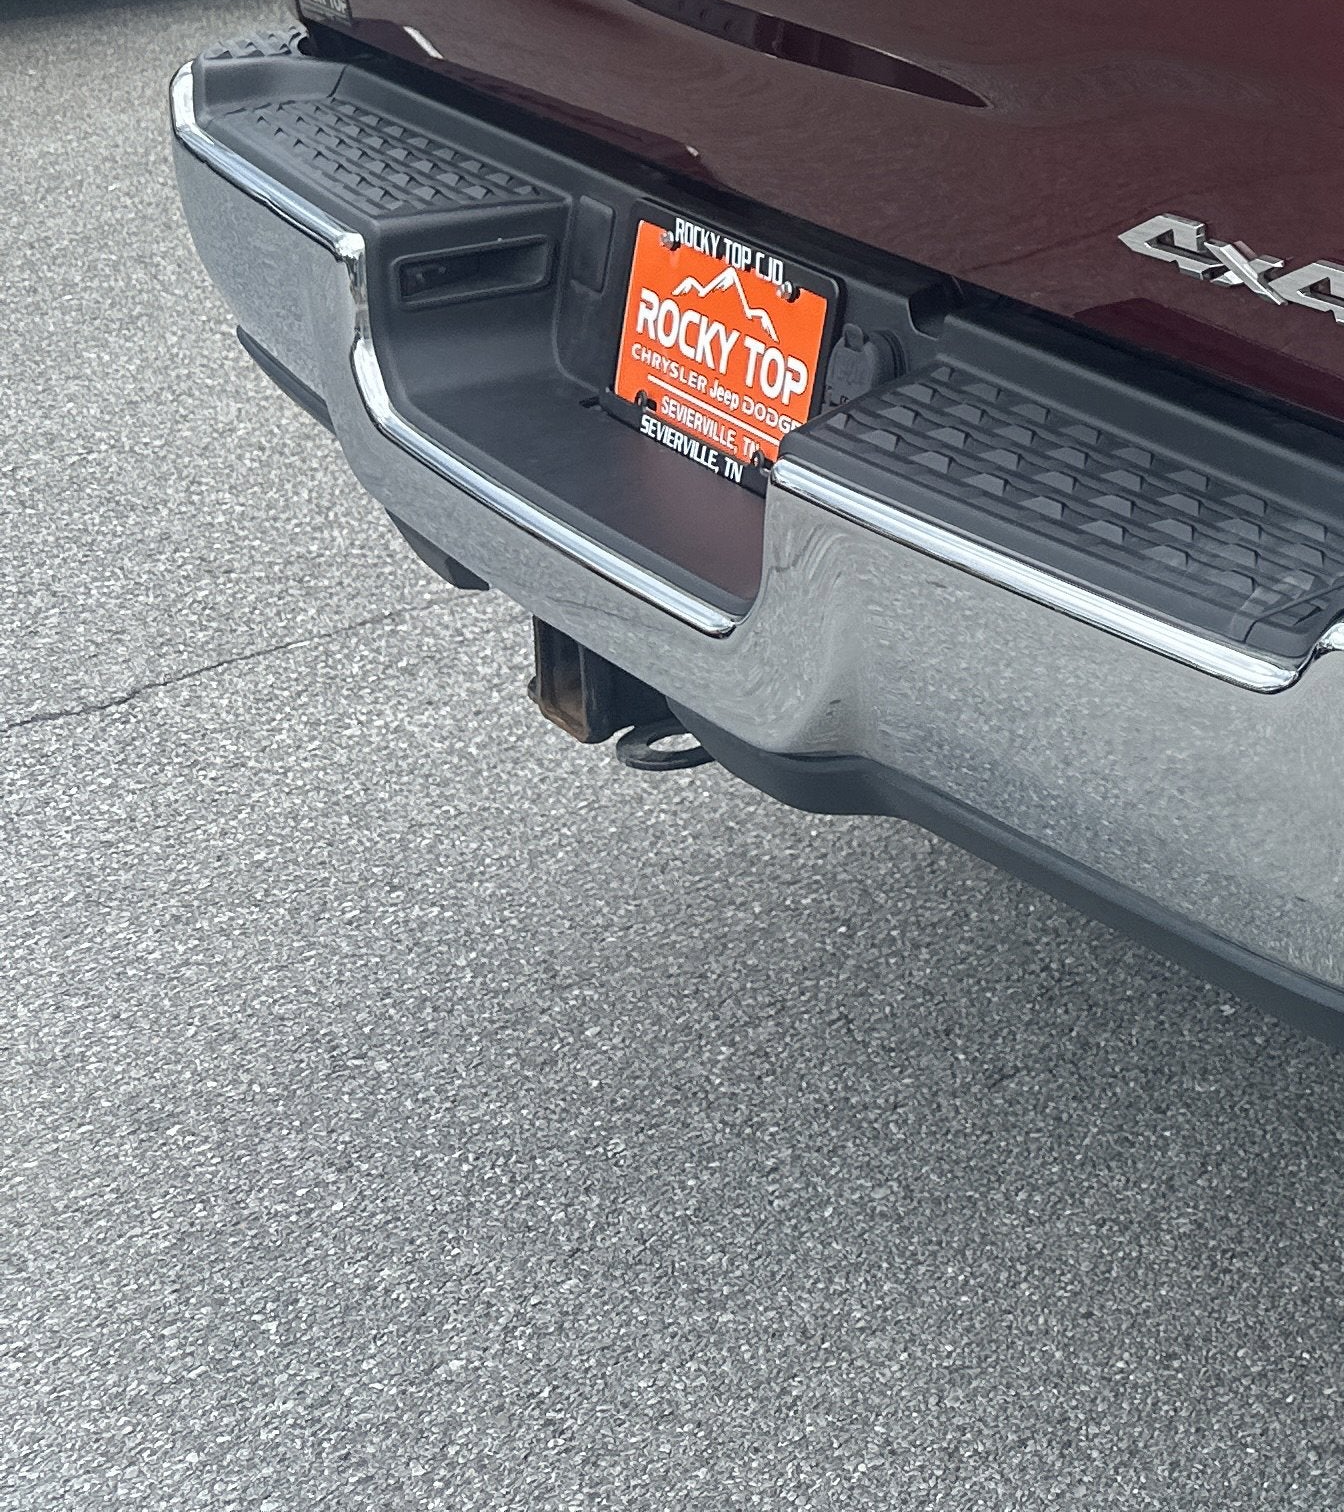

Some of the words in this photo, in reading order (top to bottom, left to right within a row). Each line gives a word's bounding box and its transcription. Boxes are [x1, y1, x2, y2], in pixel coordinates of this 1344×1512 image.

[674, 217, 722, 259] ROCKY
[722, 236, 753, 270] TOP
[754, 253, 785, 286] CJD
[630, 342, 708, 394] CHRYSLER
[709, 380, 740, 411] Jeep
[635, 287, 741, 376] ROCKY
[743, 336, 810, 406] TOP
[639, 414, 721, 474] SEVIERVILLE,
[724, 456, 745, 484] TN
[659, 394, 739, 454] SEVIERVILLE,
